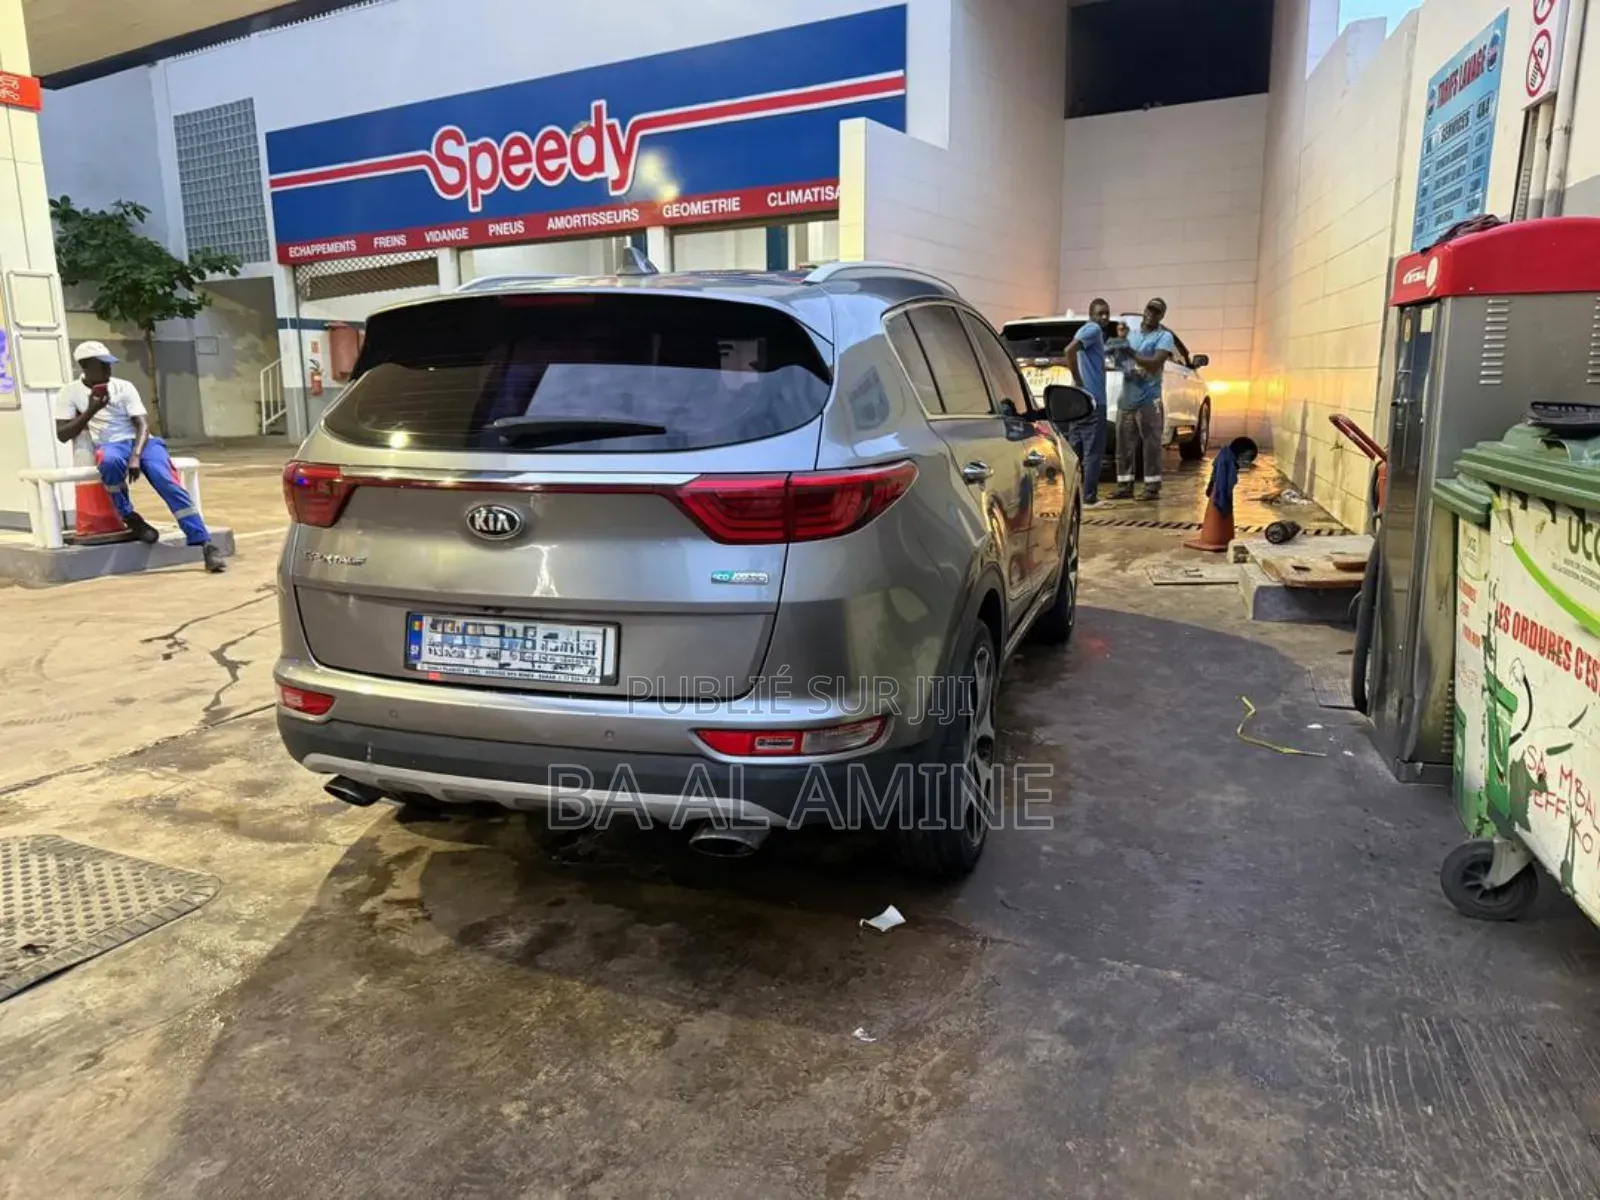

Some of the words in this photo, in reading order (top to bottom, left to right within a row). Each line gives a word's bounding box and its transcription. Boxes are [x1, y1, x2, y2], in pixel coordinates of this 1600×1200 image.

[430, 99, 640, 212] Speedy
[288, 239, 357, 258] ECHAPPEMENTS
[373, 234, 407, 249] FREINS
[424, 227, 469, 243] VIDANGE
[488, 220, 525, 236] PNEUS
[547, 208, 640, 230] AMORTISSEURS
[662, 197, 741, 218] GEOMETRIE
[474, 507, 511, 531] KIA
[1512, 611, 1572, 672] ORDURES
